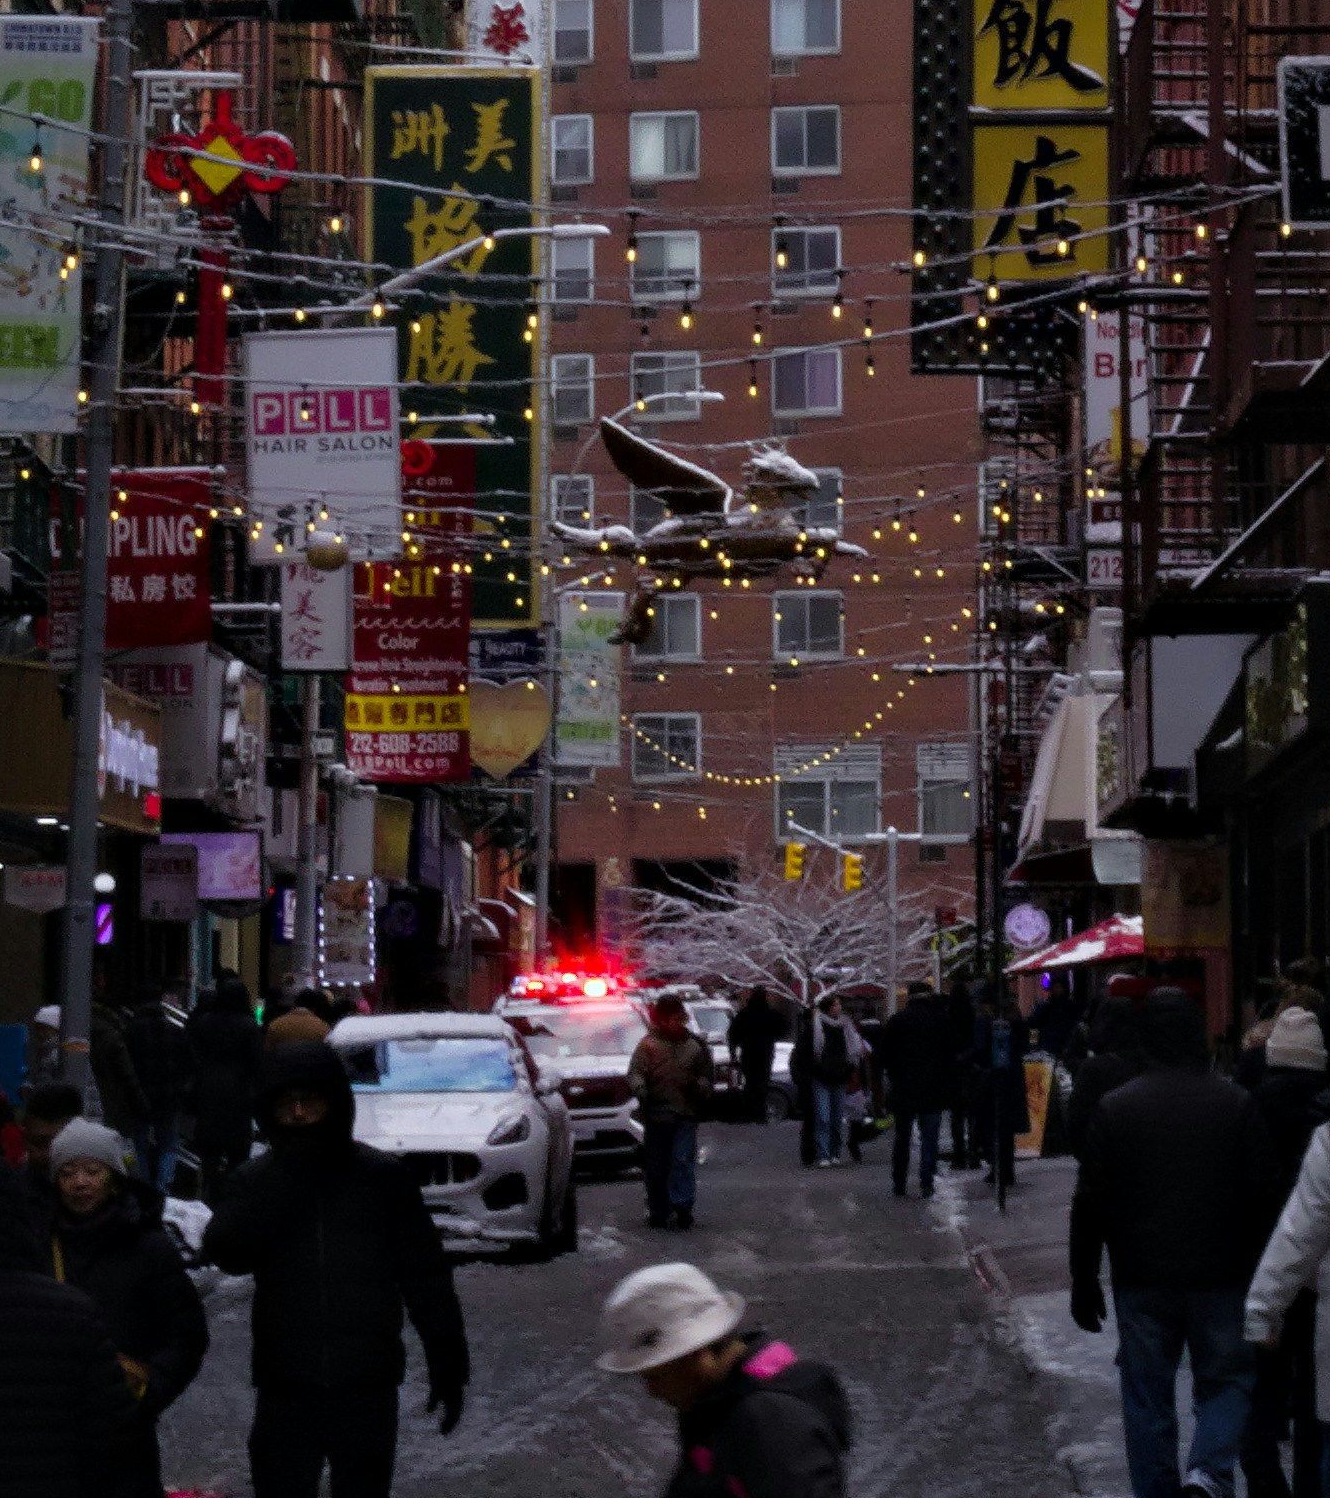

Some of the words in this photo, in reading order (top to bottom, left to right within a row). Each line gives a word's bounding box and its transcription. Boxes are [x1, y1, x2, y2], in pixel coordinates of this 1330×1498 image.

[257, 391, 388, 430] PELL
[254, 438, 307, 454] HAIR
[319, 435, 392, 452] SALON
[49, 513, 197, 558] DPLING
[1091, 556, 1122, 579] 212
[377, 633, 420, 650] Color
